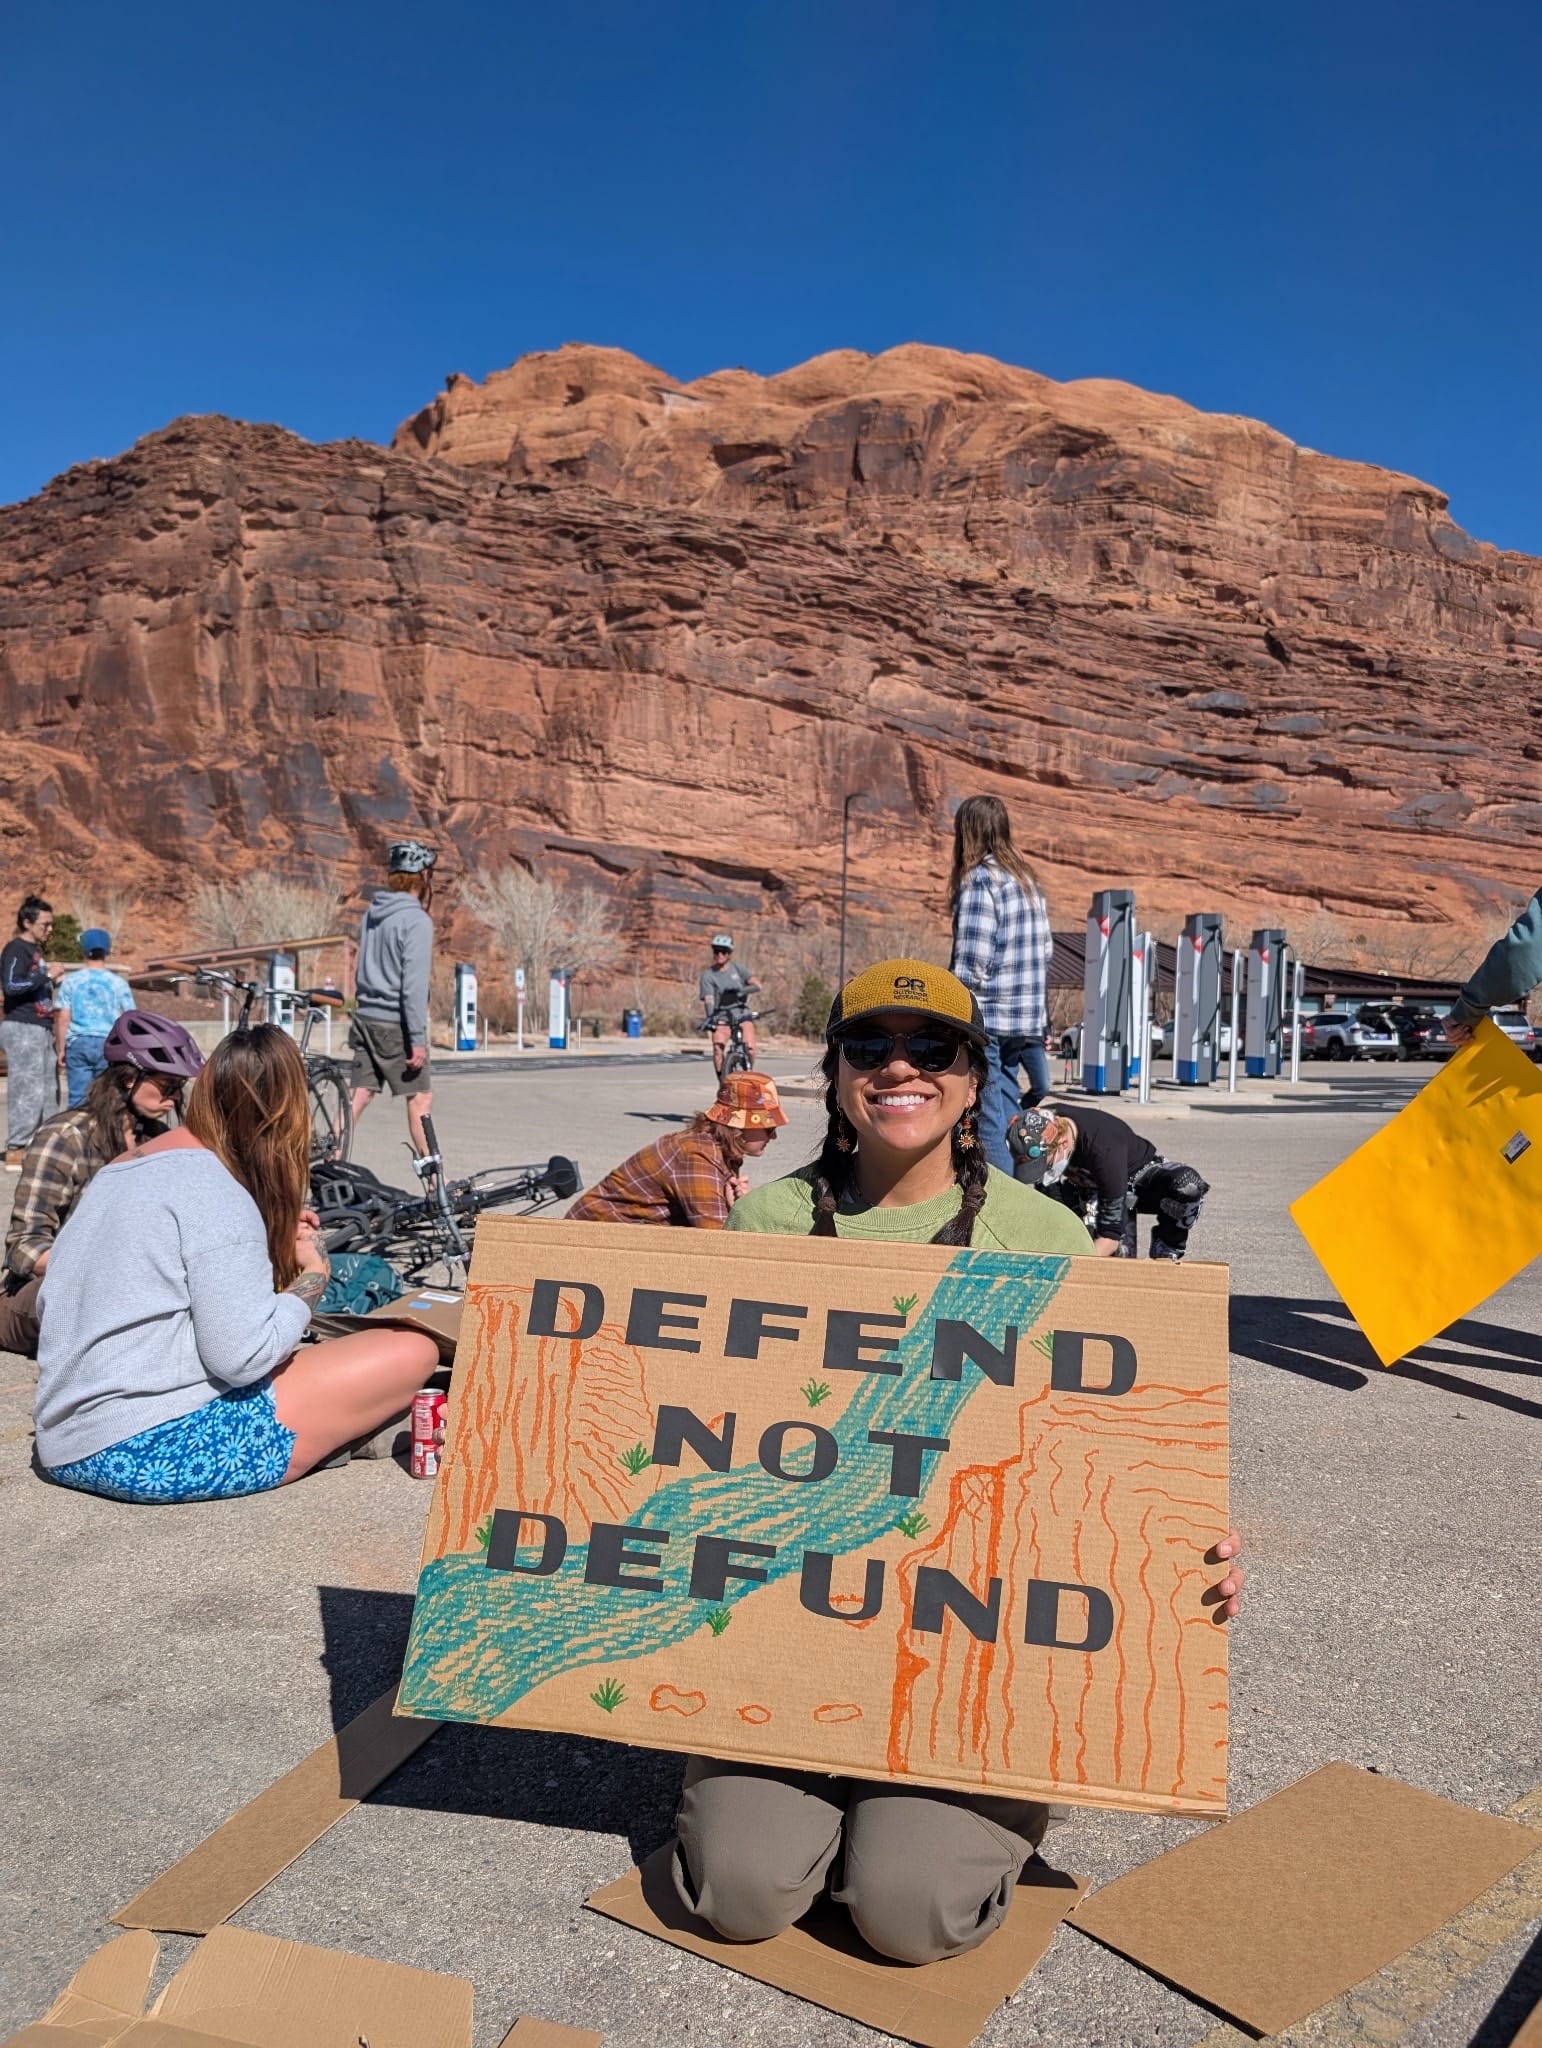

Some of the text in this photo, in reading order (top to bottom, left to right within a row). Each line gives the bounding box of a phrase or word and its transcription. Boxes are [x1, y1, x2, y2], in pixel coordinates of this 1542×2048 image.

[894, 976, 926, 992] OR
[526, 1278, 1138, 1398] DEFEND
[651, 1404, 950, 1498] NOT
[485, 1508, 1115, 1653] DEFUND
